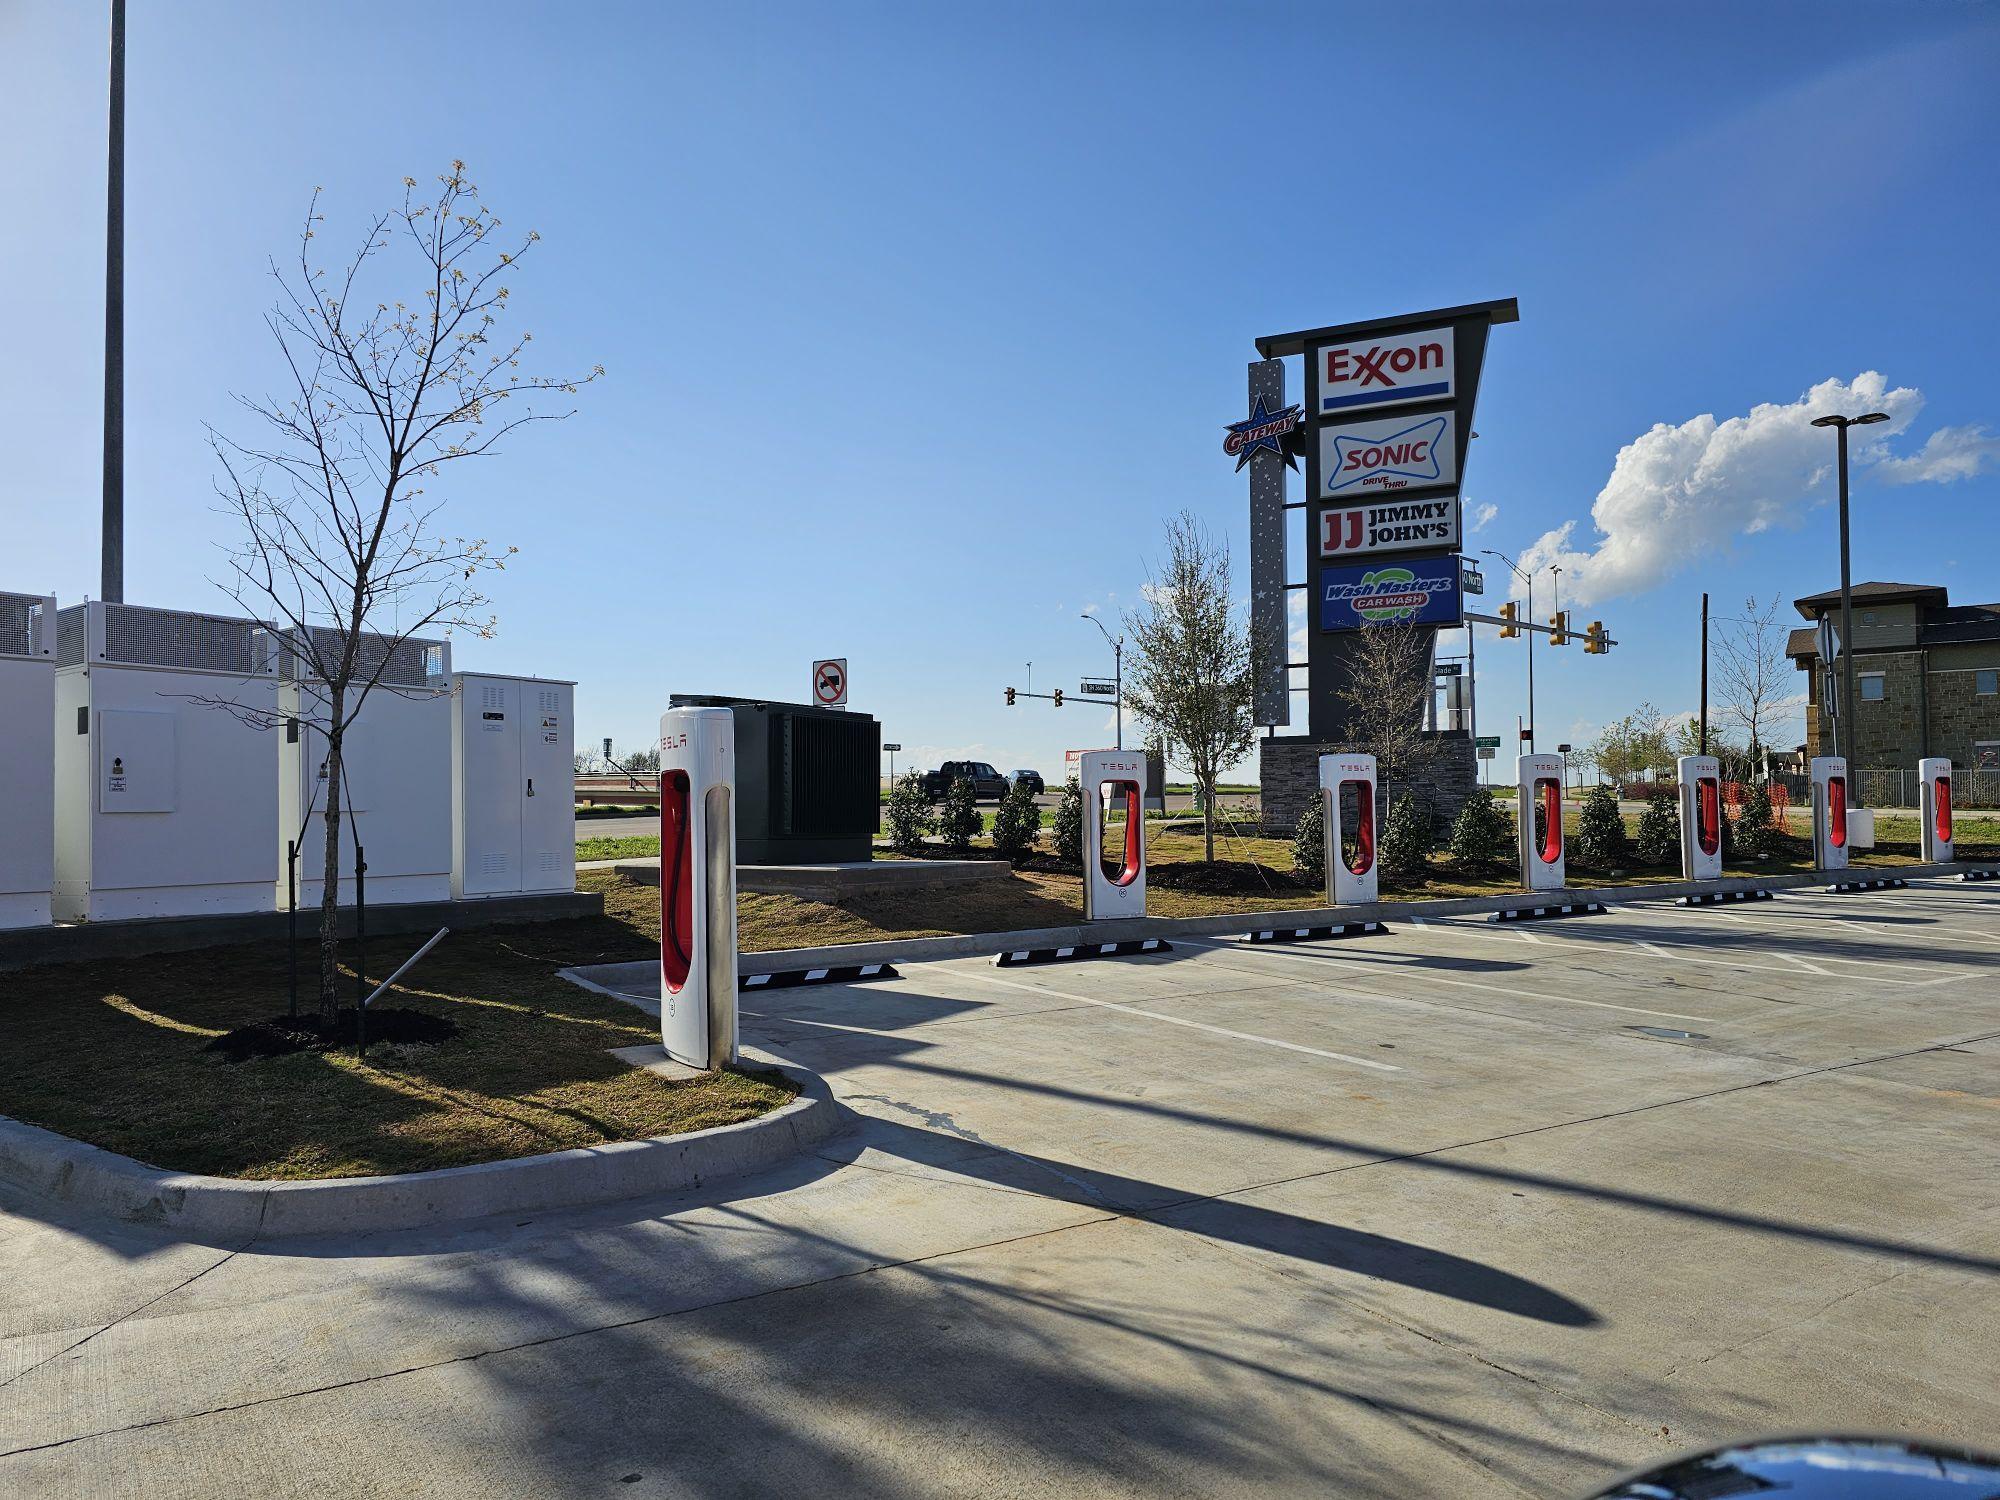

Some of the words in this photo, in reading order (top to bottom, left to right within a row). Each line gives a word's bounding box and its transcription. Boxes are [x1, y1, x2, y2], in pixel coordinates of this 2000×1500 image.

[1327, 343, 1443, 387] Exxon
[1225, 415, 1298, 453] GATEWAY
[1342, 441, 1429, 471] SONIC
[1362, 476, 1389, 486] DRIVE
[1383, 480, 1408, 490] THRU
[1368, 502, 1450, 527] JIMMY
[1323, 510, 1364, 550] JJ
[1368, 522, 1450, 547] JOHN'S
[1326, 583, 1375, 599] Wash
[1375, 579, 1450, 595] Masters
[1357, 598, 1384, 608] CAR
[1385, 596, 1422, 605] WASH
[1101, 763, 1138, 771] TESLA
[1340, 764, 1370, 772] TESLA
